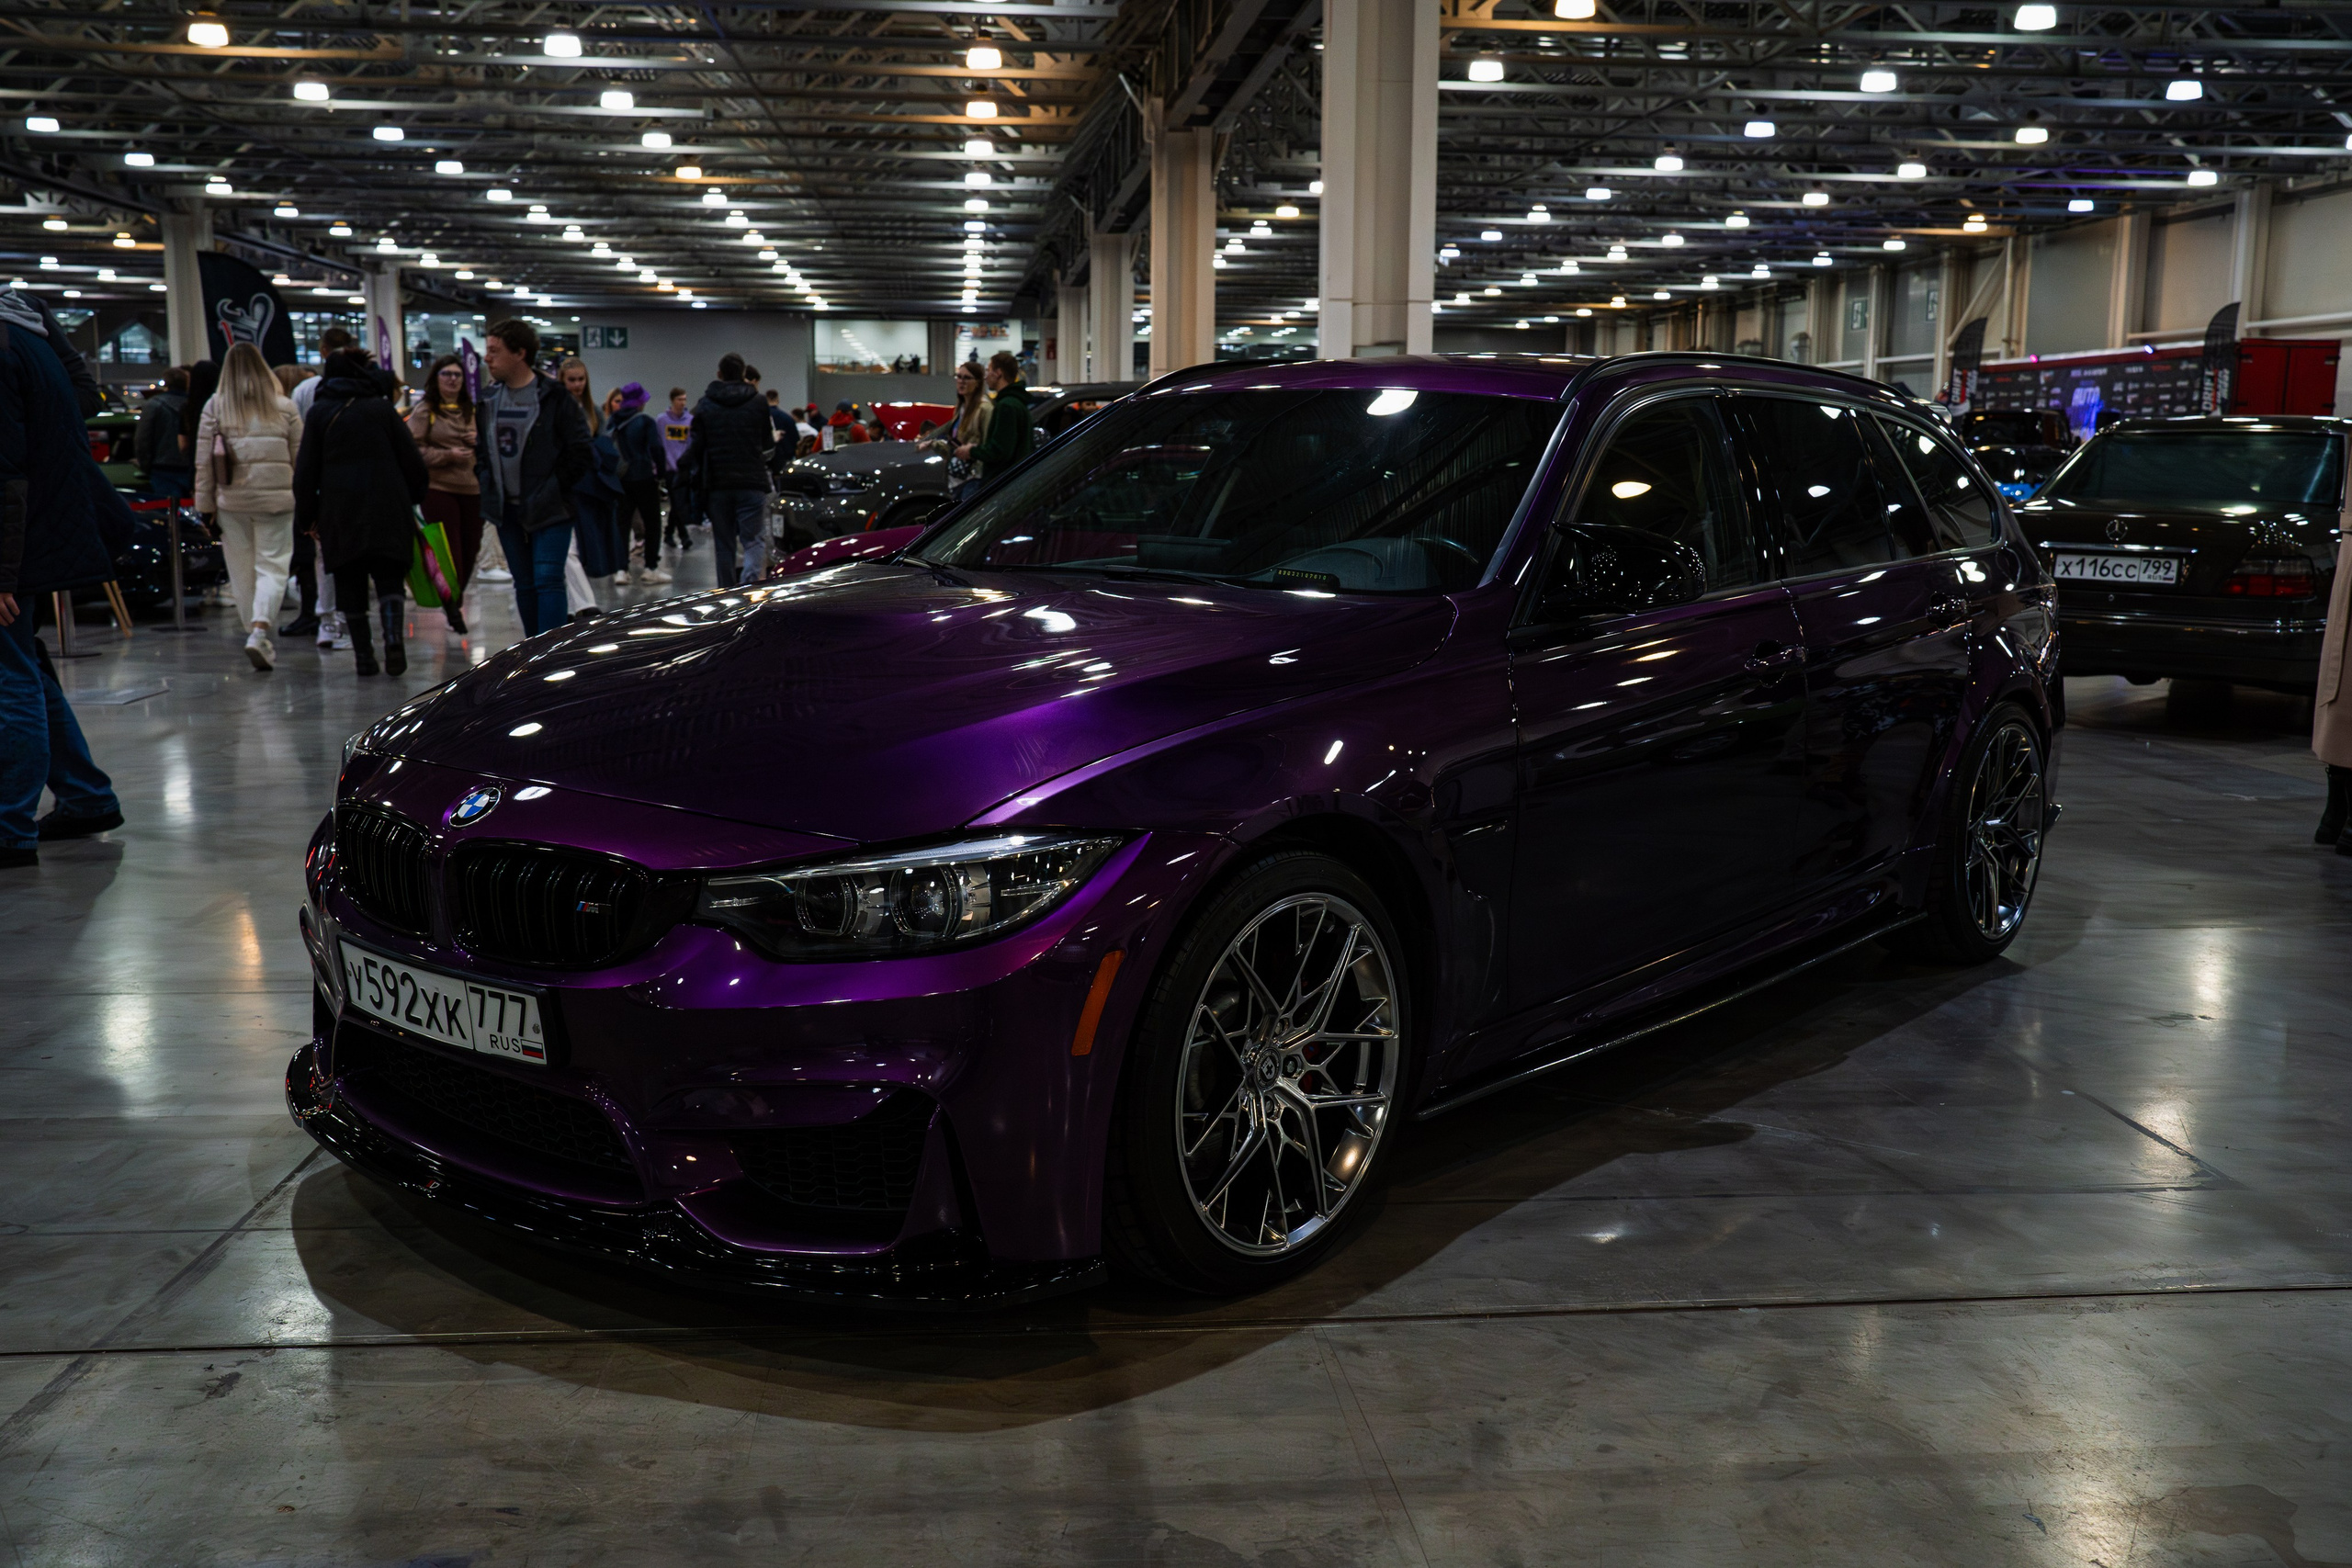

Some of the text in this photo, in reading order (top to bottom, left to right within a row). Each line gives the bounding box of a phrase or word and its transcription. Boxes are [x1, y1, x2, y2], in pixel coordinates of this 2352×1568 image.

[2143, 559, 2172, 576] 799
[350, 957, 526, 1039] У592ХК 777
[490, 1033, 521, 1054] RUS
